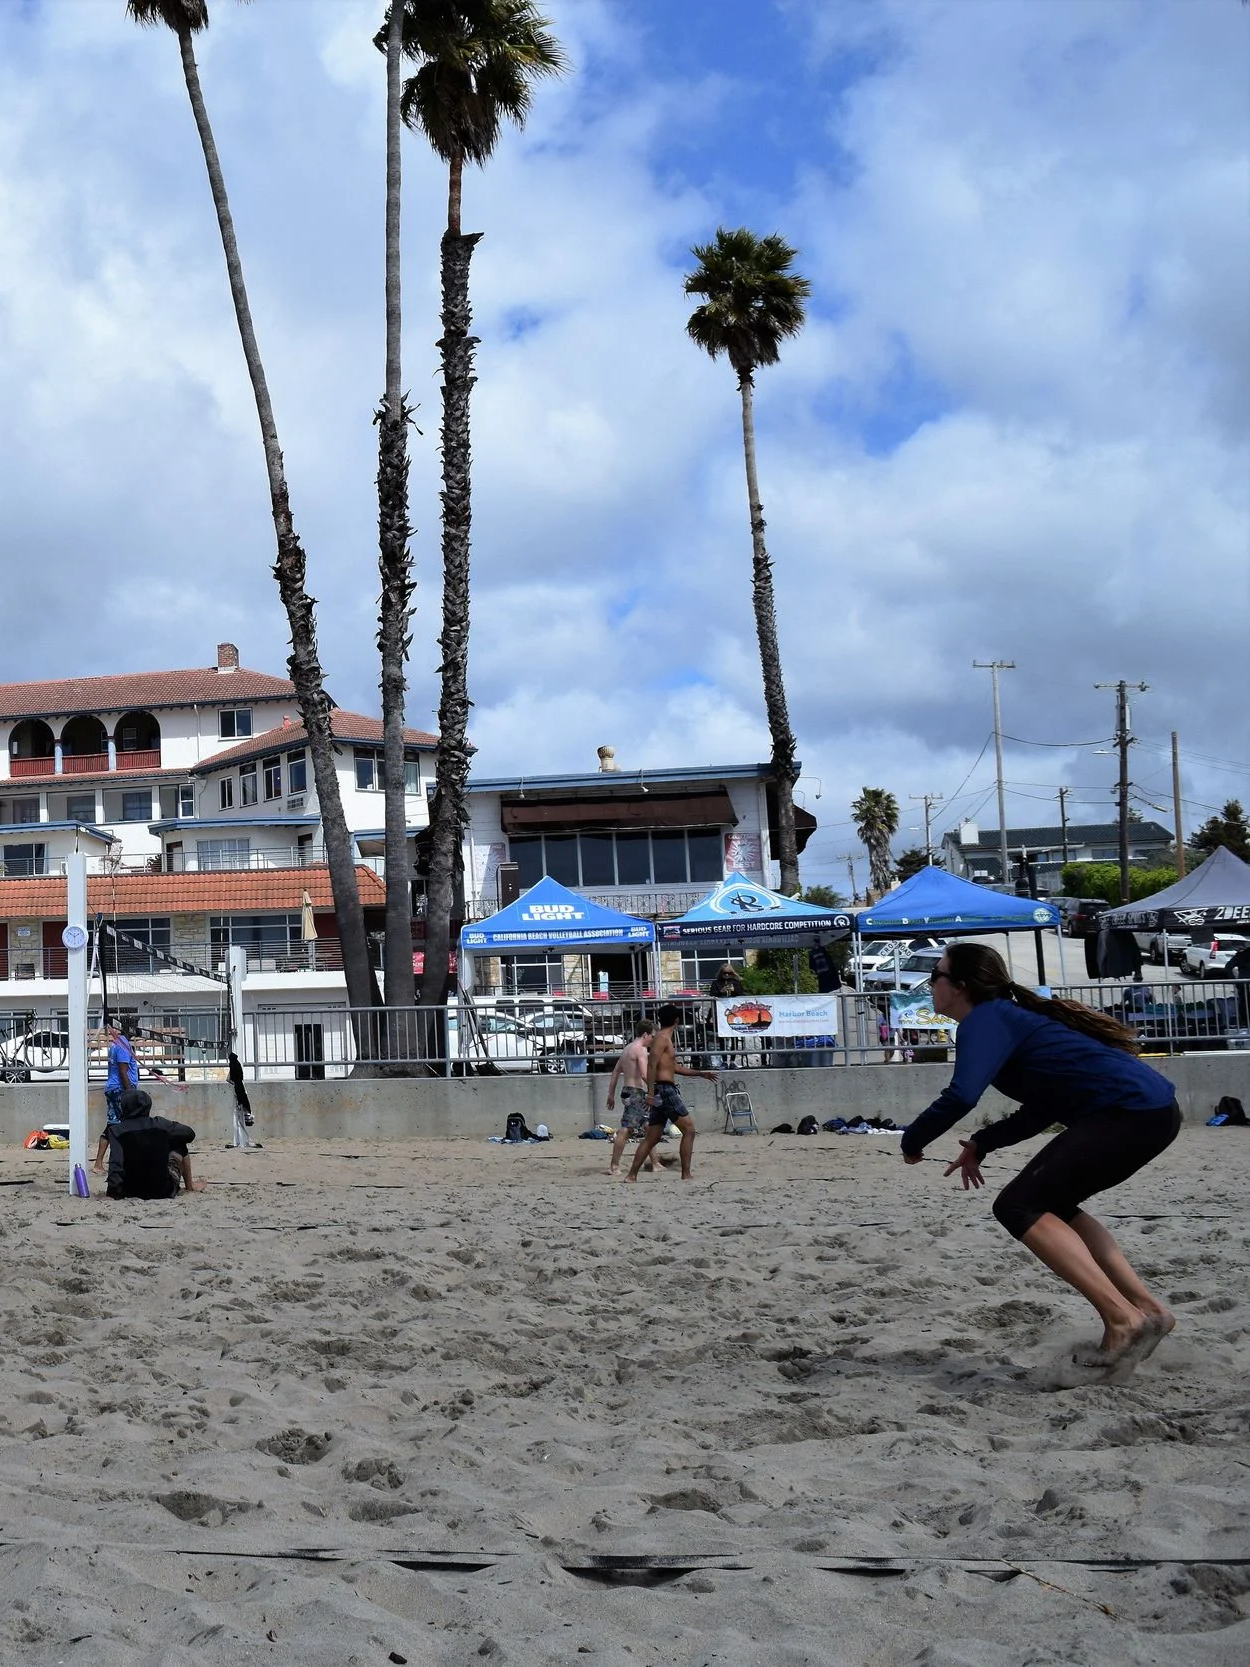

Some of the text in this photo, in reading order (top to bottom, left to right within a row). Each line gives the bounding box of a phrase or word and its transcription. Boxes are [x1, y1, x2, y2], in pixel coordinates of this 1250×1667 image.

[529, 904, 575, 913] BUD
[1213, 906, 1250, 921] 2DEE
[522, 911, 585, 921] LIGHT
[682, 926, 713, 935] SERIOUS
[713, 925, 732, 934] GEAR
[732, 924, 746, 932] FOR
[747, 922, 784, 932] HARDCORE
[784, 919, 832, 930] COMPETITION
[492, 928, 624, 942] CALIFORNIA BEACH VOLLEYBALL ASSOCIATION
[778, 1009, 828, 1018] Harbor Beach
